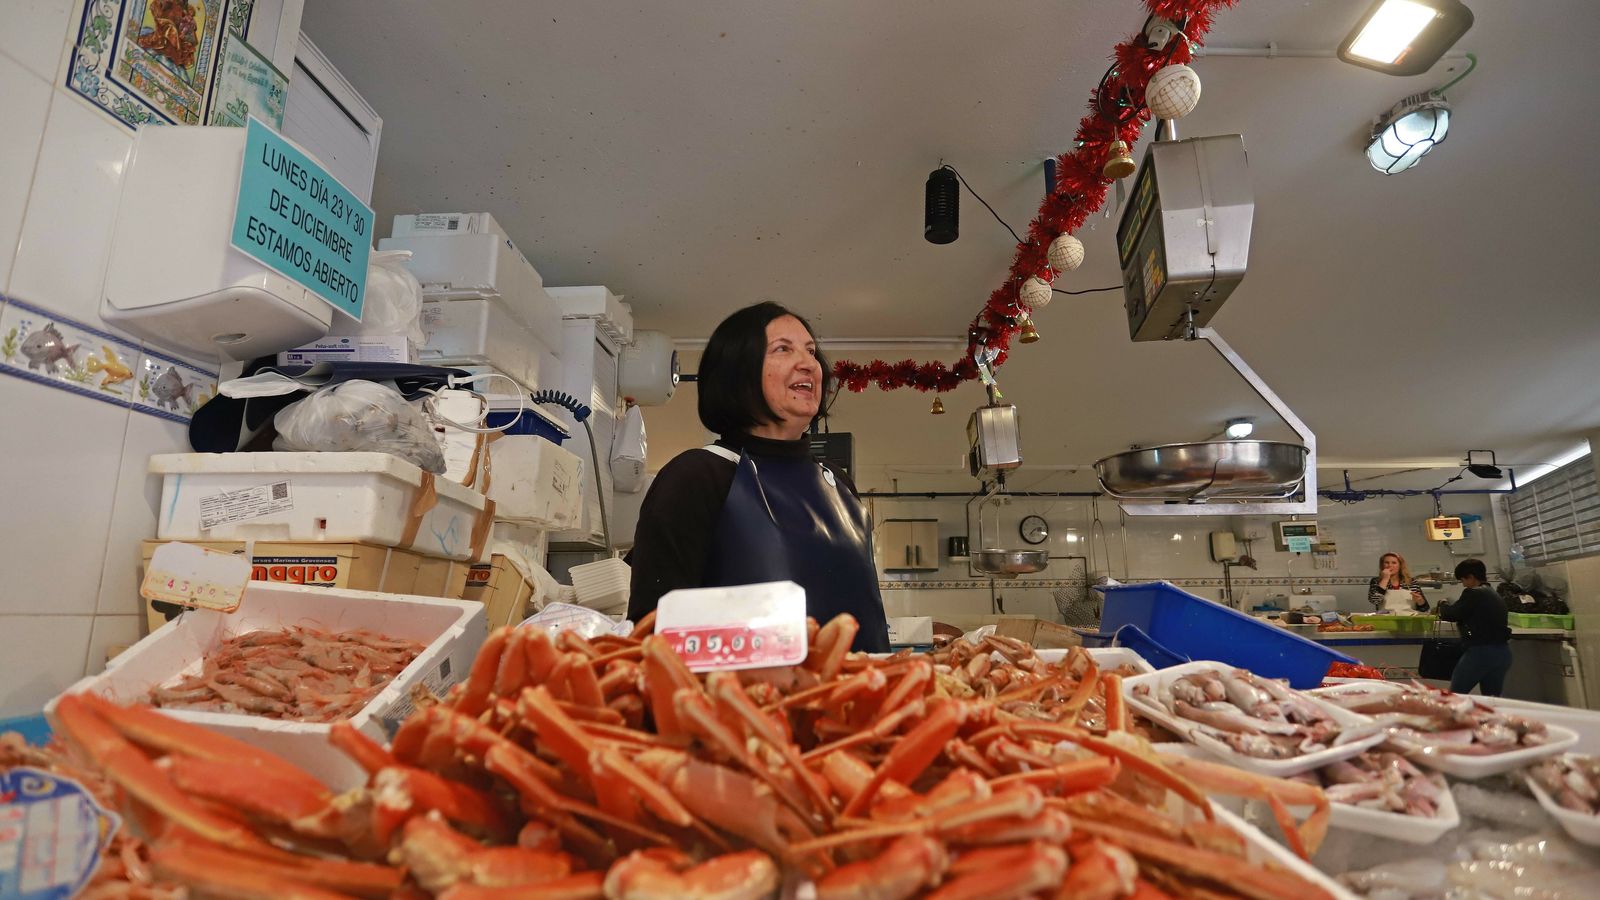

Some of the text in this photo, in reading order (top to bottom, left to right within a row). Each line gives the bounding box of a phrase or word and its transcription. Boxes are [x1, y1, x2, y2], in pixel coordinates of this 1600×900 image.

[262, 143, 365, 236] LUNES DÍA 23 Y 30
[269, 188, 353, 264] DE DICIEMBRE
[246, 215, 359, 303] ESTAMOS ABIERTO
